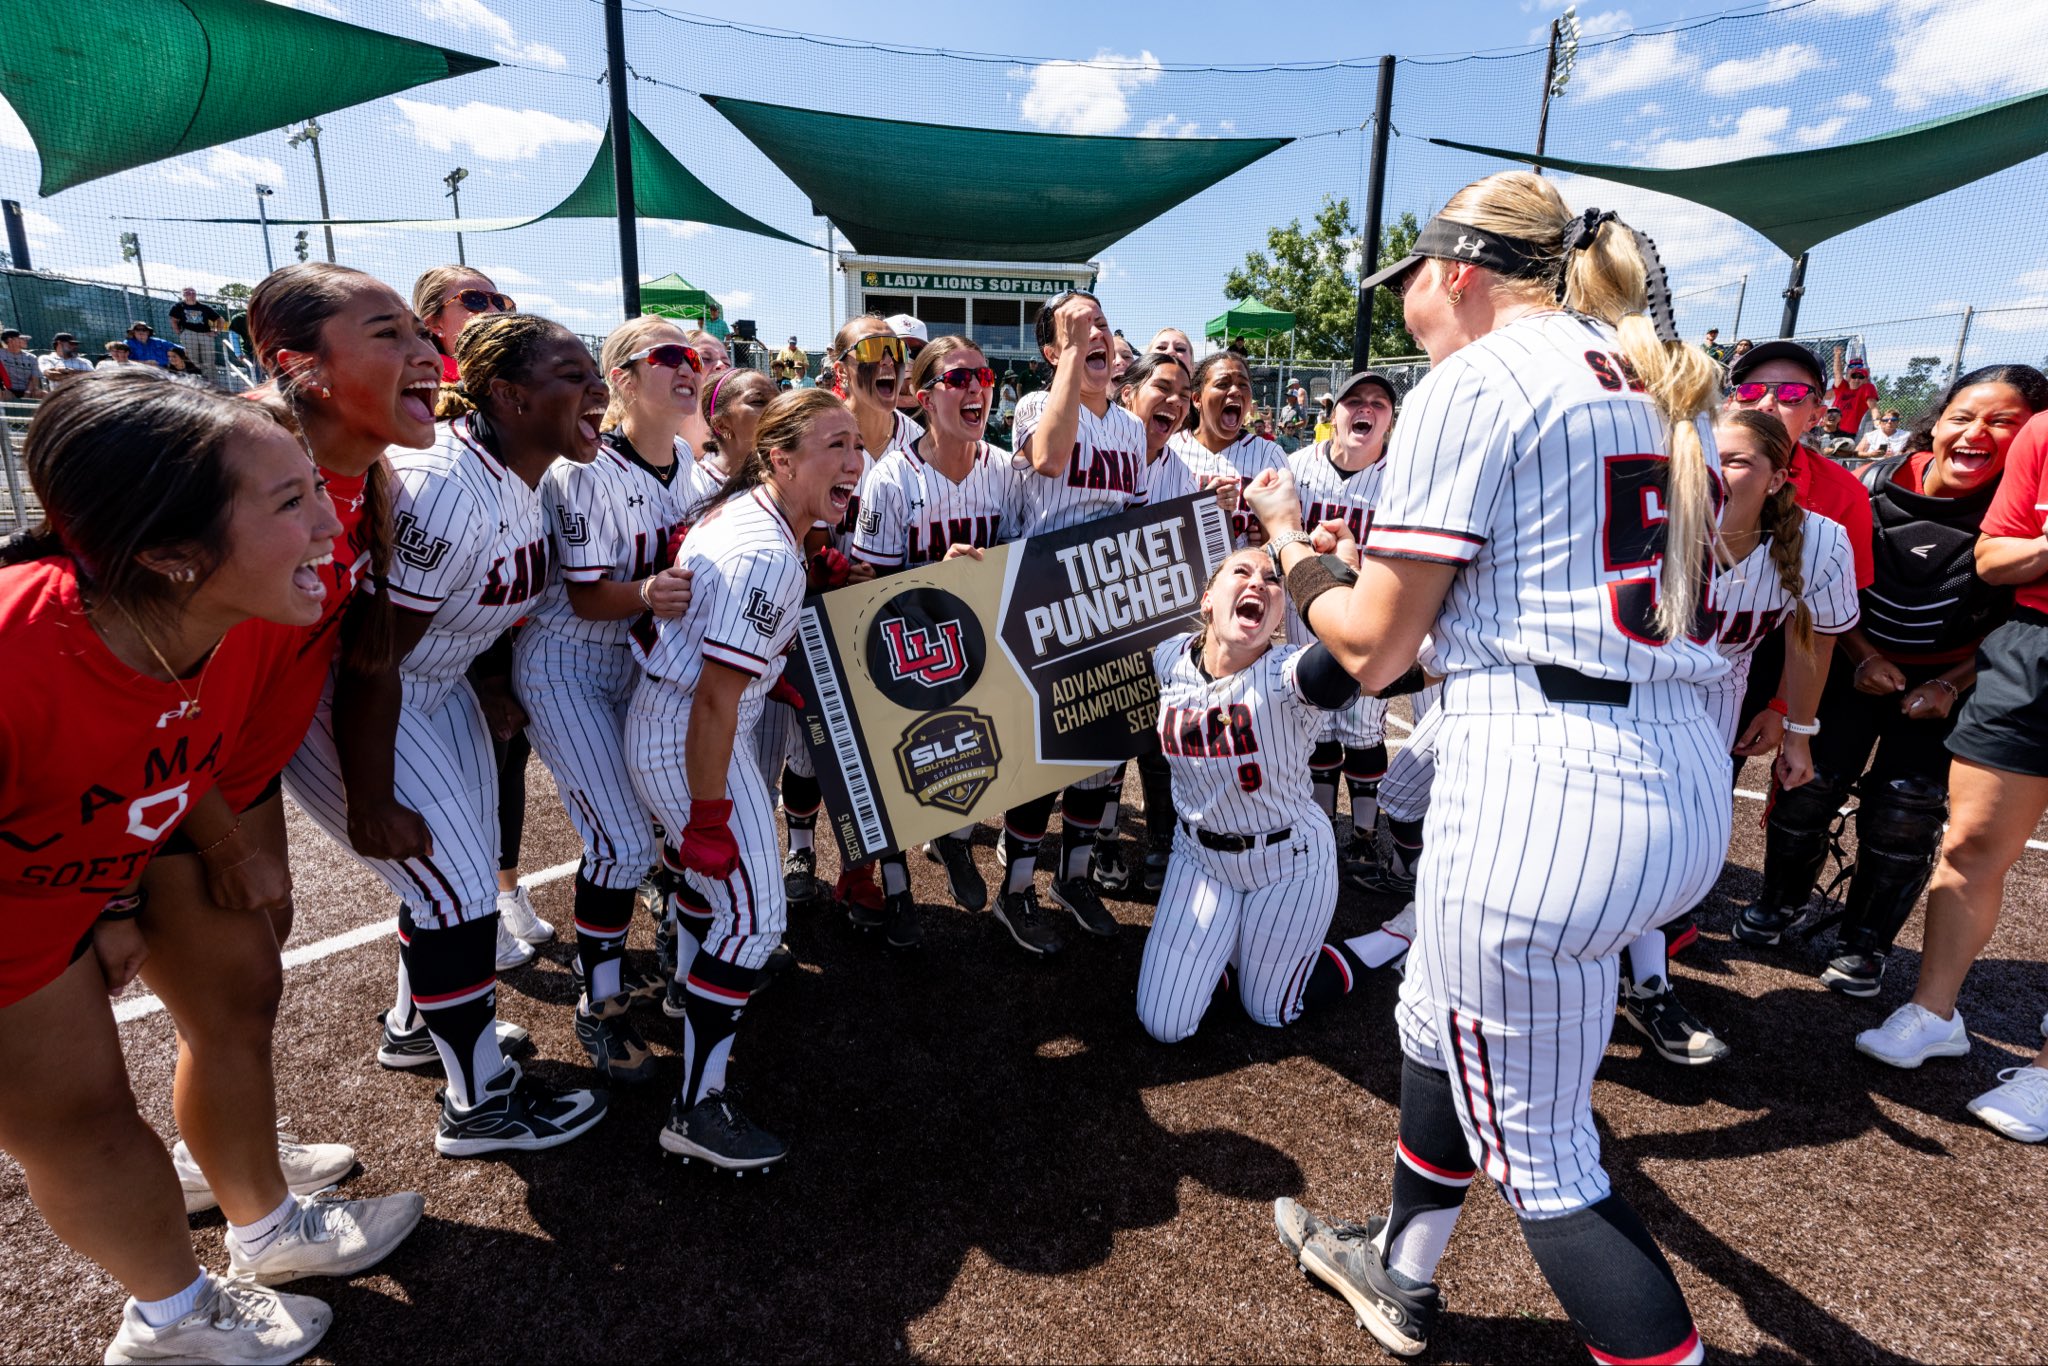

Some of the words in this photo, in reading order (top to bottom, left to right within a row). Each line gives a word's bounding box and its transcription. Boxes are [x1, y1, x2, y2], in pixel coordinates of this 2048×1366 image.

[884, 274, 928, 288] LADY
[933, 276, 984, 291] LIONS
[392, 511, 452, 572] LU
[556, 505, 591, 546] LU
[909, 514, 1000, 563] LAMA
[1055, 516, 1186, 595] TICKET
[742, 587, 785, 639] LU
[1024, 562, 1199, 657] PUNCHED
[880, 617, 969, 689] LU
[1052, 651, 1147, 706] ADVANCING
[806, 715, 817, 723] 7
[1053, 674, 1161, 734] CHAMPIONSH
[1126, 702, 1158, 734] SER
[808, 721, 826, 746] ROW
[910, 729, 979, 768] SLC
[1160, 703, 1259, 758] AMAR
[915, 747, 982, 776] SOUTHLAND
[933, 761, 974, 780] SOFTBALL
[1237, 762, 1263, 792] 9
[0, 732, 224, 852] LAMA
[927, 769, 986, 795] CHAMPIONSHIP
[838, 813, 850, 822] 5
[841, 822, 862, 862] SECTION
[16, 849, 148, 888] SOFT
